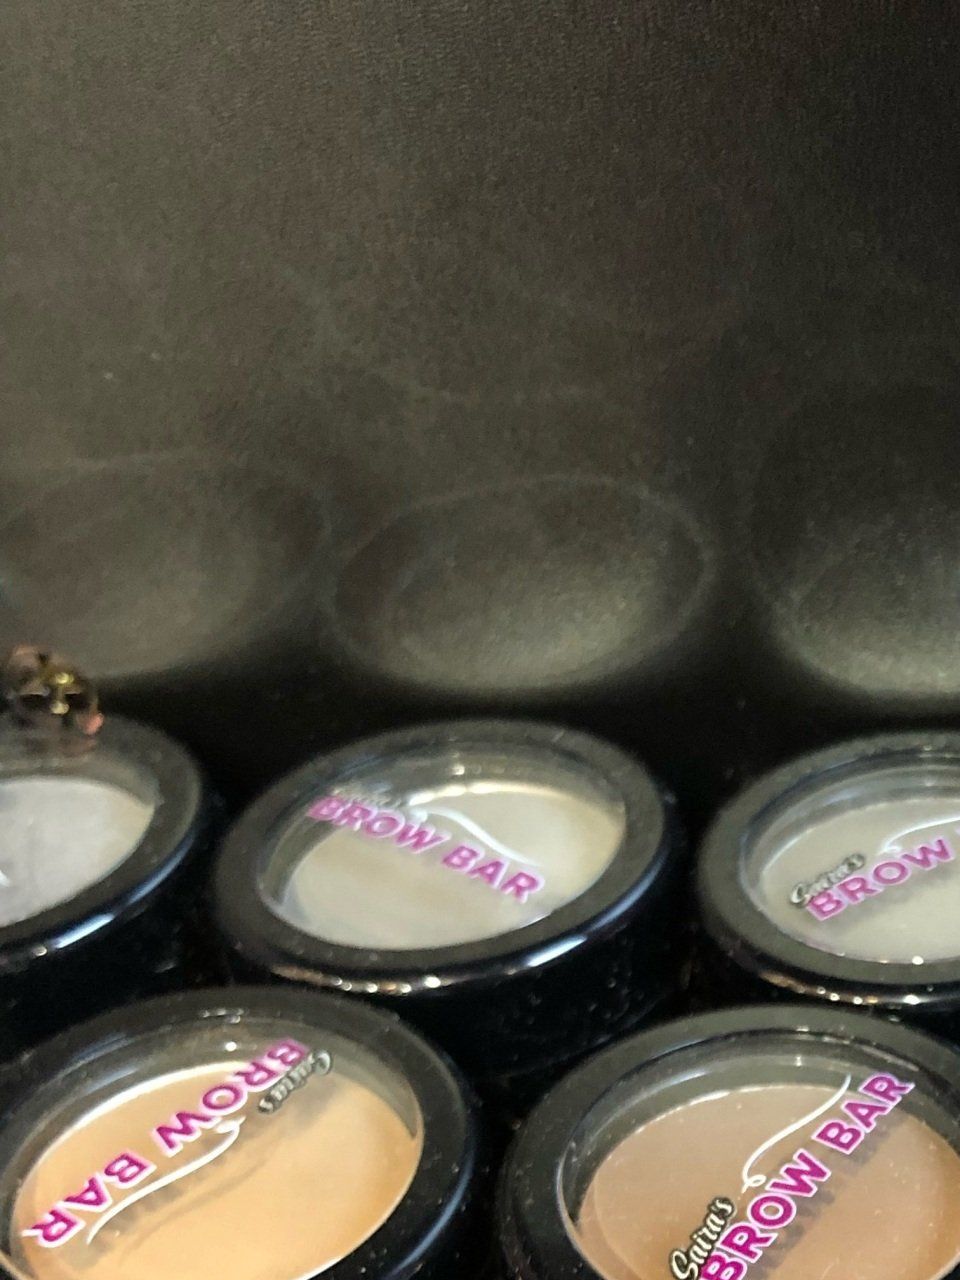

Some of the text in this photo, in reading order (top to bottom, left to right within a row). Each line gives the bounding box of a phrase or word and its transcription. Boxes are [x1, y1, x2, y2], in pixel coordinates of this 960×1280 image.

[306, 796, 545, 903] BROW BAR
[806, 837, 956, 921] BROW
[22, 1039, 308, 1248] BROW BAR
[811, 1071, 916, 1155] BAR
